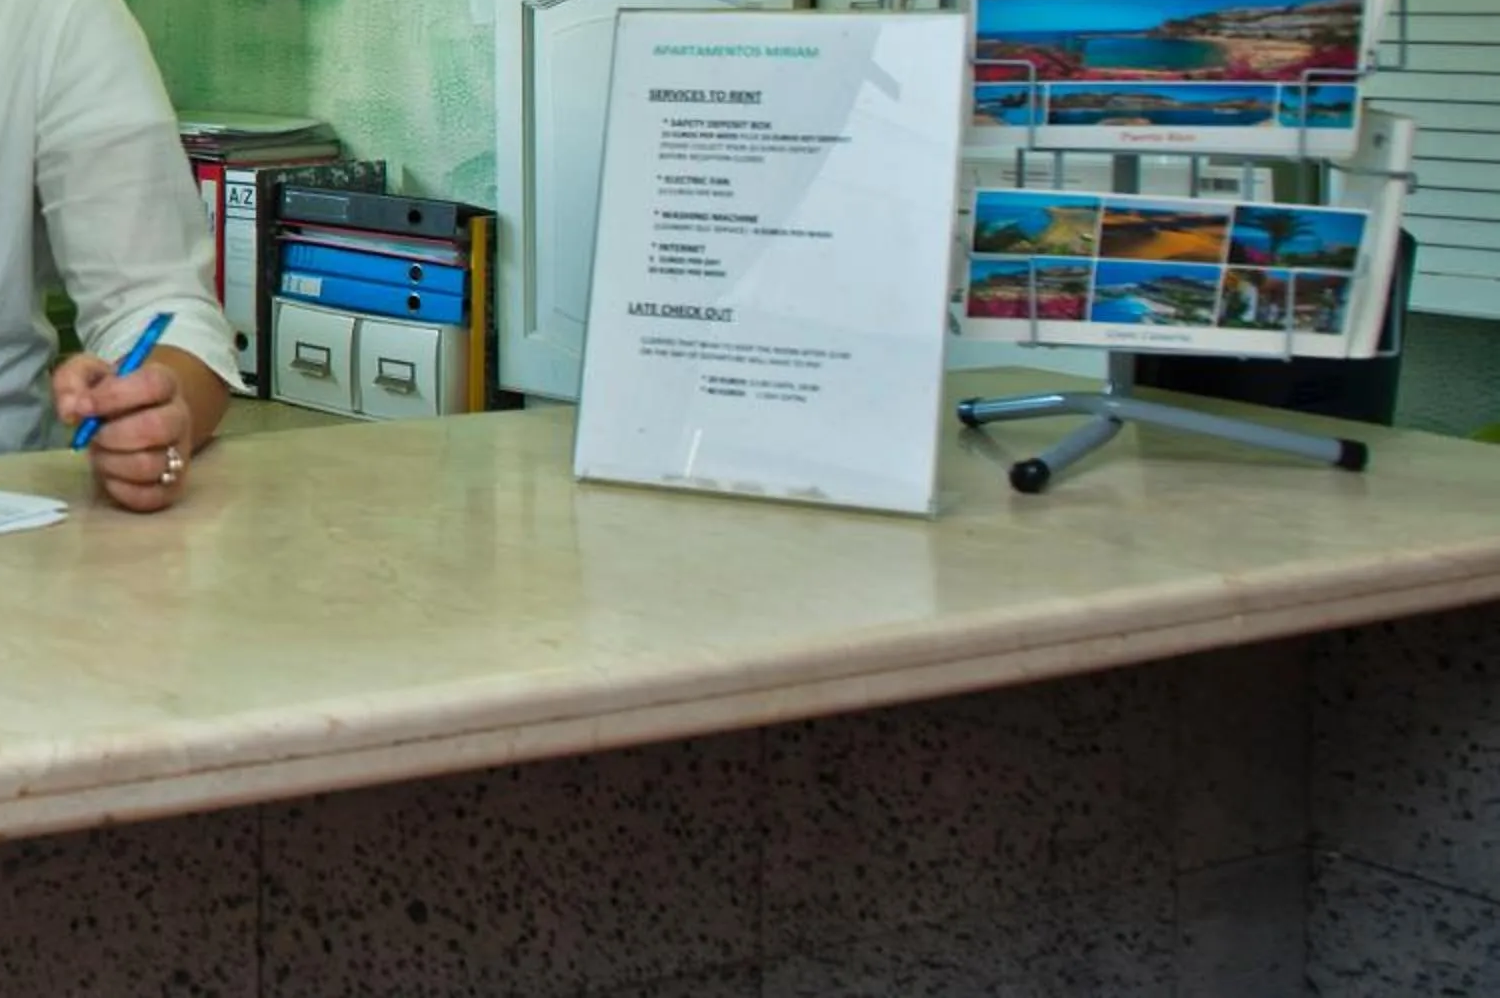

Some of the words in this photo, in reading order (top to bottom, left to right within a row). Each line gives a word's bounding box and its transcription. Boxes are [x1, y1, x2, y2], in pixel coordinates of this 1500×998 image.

[653, 44, 762, 58] APARTAMENTOS
[765, 46, 820, 59] MIRIAM
[649, 88, 706, 103] SERVICES
[709, 89, 726, 103] TO
[729, 90, 761, 105] RENT
[670, 119, 705, 128] SAFETY
[664, 175, 707, 185] ELECTRIC
[710, 177, 730, 186] FAN
[662, 211, 709, 221] WASHING
[712, 213, 758, 223] MACHINE
[659, 243, 706, 254] INTERNET
[628, 302, 661, 317] LATE
[661, 304, 702, 320] CHECK
[705, 307, 734, 322] OUT
